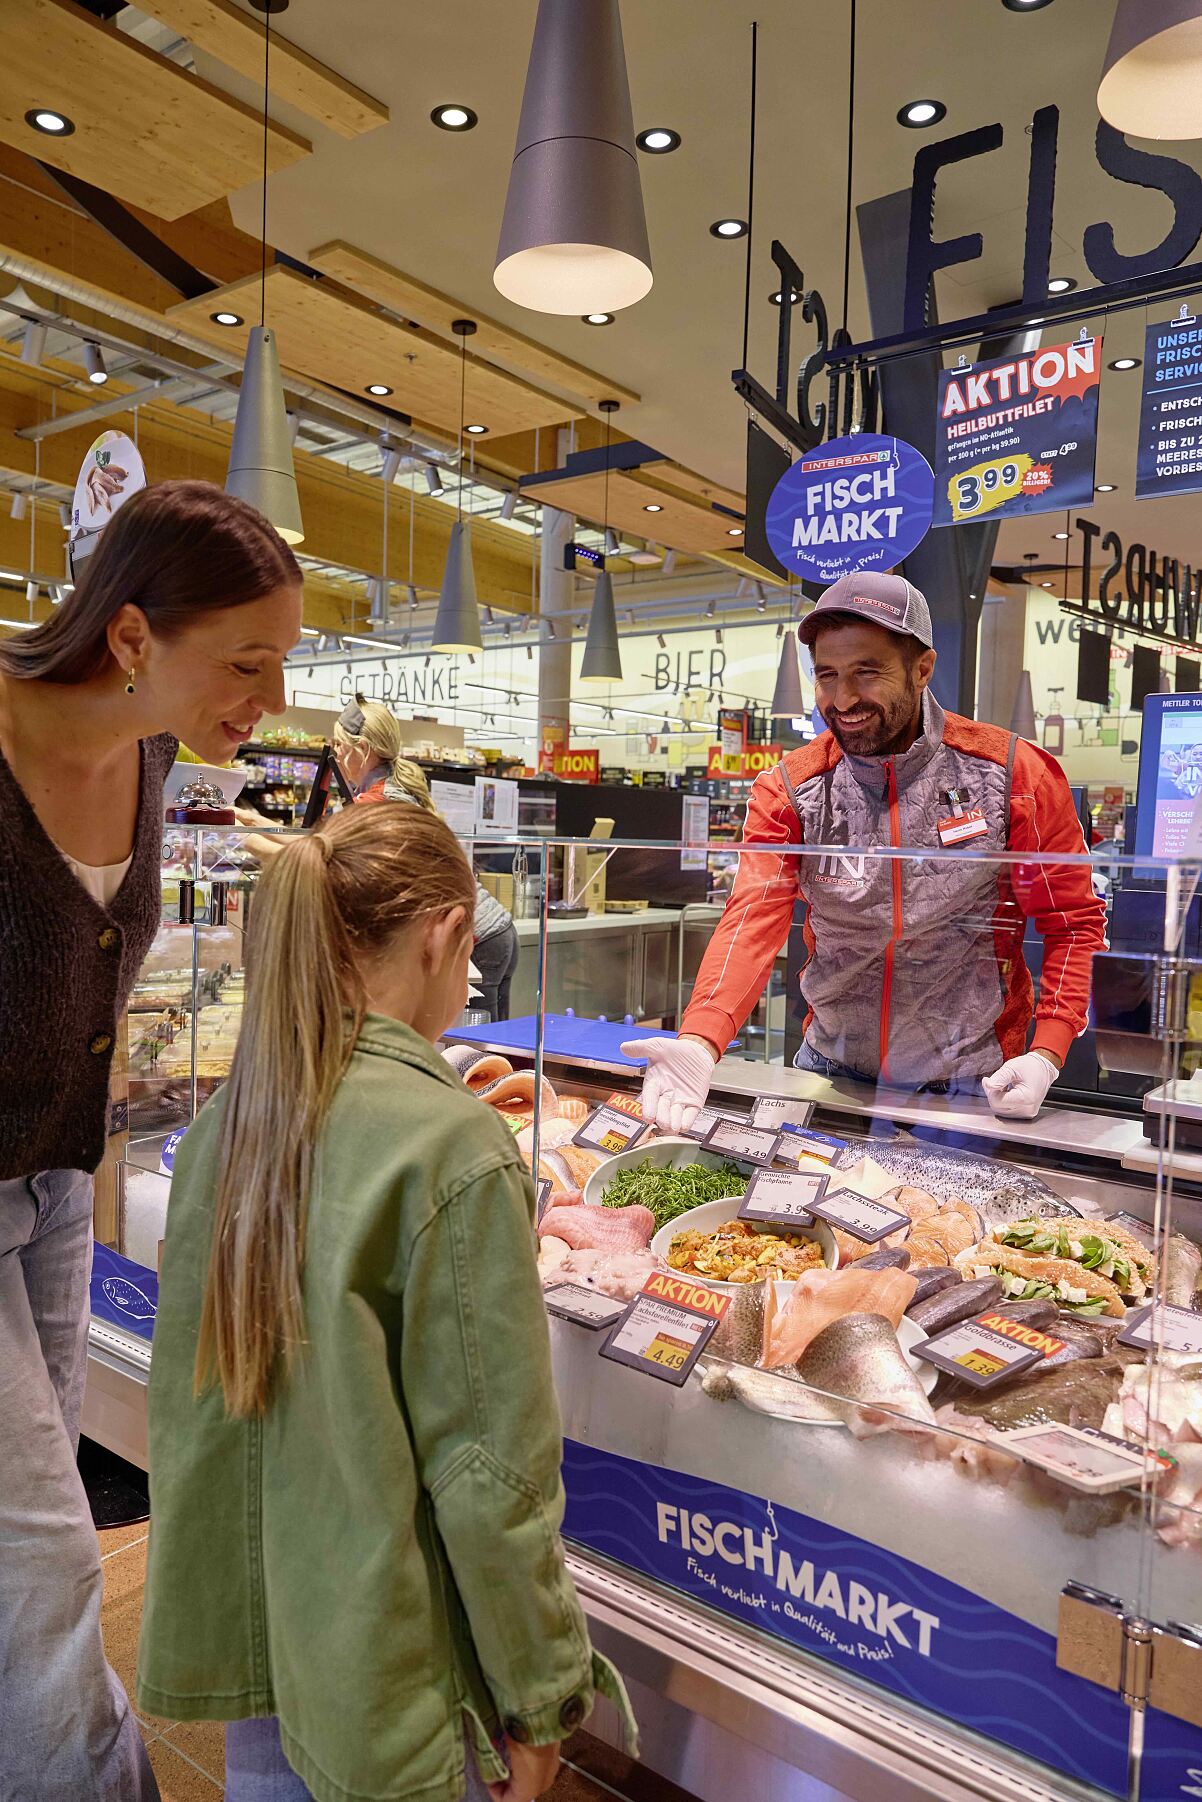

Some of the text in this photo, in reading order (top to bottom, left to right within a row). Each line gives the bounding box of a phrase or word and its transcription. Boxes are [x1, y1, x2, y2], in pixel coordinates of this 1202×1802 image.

[943, 346, 1095, 417] AKTION
[947, 397, 1054, 439] HEILBUTTFILET
[1158, 439, 1176, 451] BIS
[1180, 437, 1195, 447] ZU
[809, 454, 878, 470] INTERSPAR
[807, 466, 896, 516] FISCH
[792, 507, 904, 547] MARKT
[797, 550, 815, 564] Fisch
[817, 557, 845, 569] verliebt
[858, 550, 884, 567] Preis!
[655, 650, 726, 691] BIER
[1162, 700, 1190, 708] METTLER
[760, 1100, 786, 1108] Lachs
[603, 1139, 623, 1153] 3.99
[743, 1147, 767, 1158] 3.49
[758, 1177, 792, 1186] Fischpfanne
[843, 1190, 890, 1216] Lachssteak
[850, 1218, 878, 1234] 3.99
[648, 1275, 727, 1315] AKTION
[635, 1305, 689, 1329] Lachsforellenfilet
[640, 1297, 656, 1311] SPAR
[656, 1302, 687, 1320] PREMIUM
[964, 1323, 1018, 1351] Goldbrasse
[981, 1316, 1061, 1354] AKTION
[653, 1349, 685, 1369] 4.49
[687, 1556, 717, 1588] Fisch
[721, 1585, 768, 1608] verliebt
[771, 1601, 780, 1613] in
[784, 1602, 838, 1643] Qualität
[857, 1640, 894, 1661] Preis!
